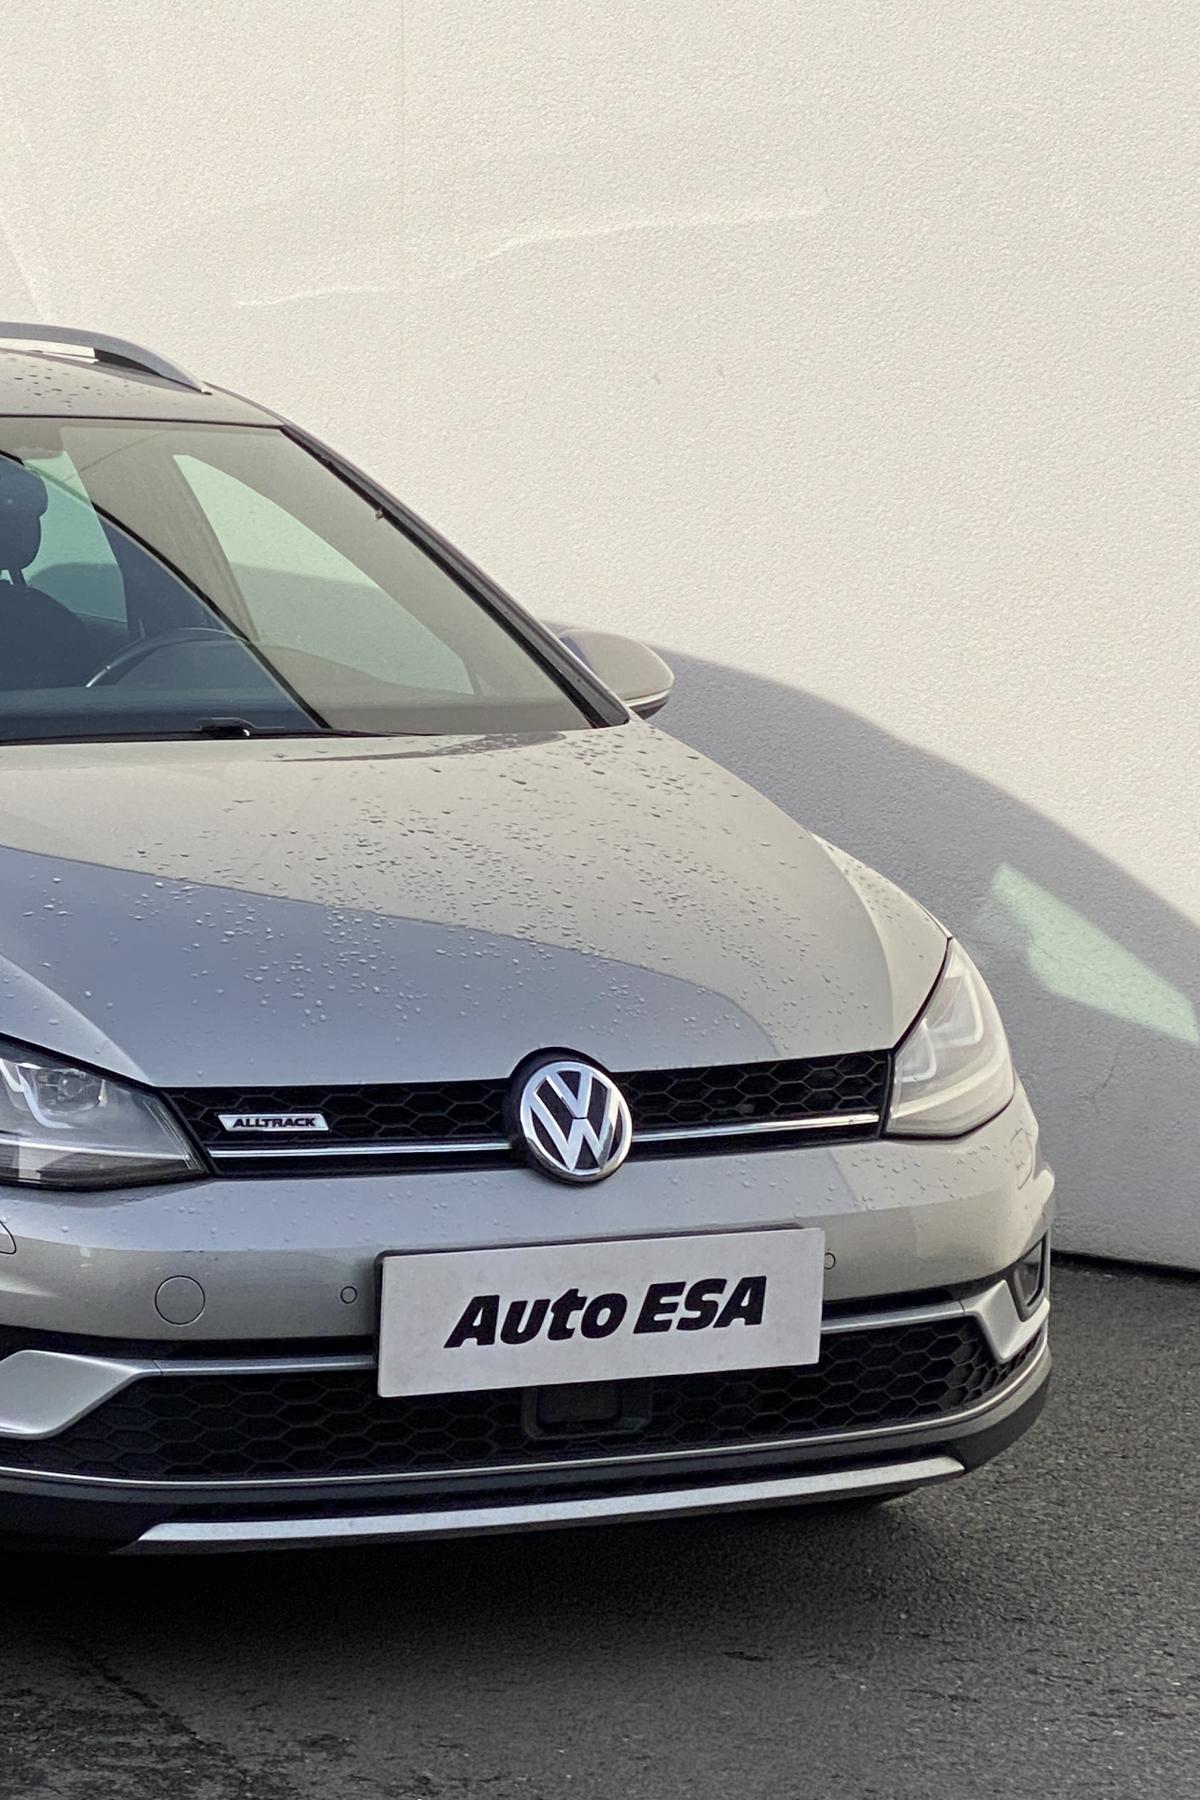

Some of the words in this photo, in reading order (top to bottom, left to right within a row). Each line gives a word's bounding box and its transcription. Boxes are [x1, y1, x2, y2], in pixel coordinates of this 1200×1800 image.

[232, 1117, 316, 1128] ALLTRACK
[443, 1288, 628, 1349] Auto
[632, 1275, 768, 1335] ESA
